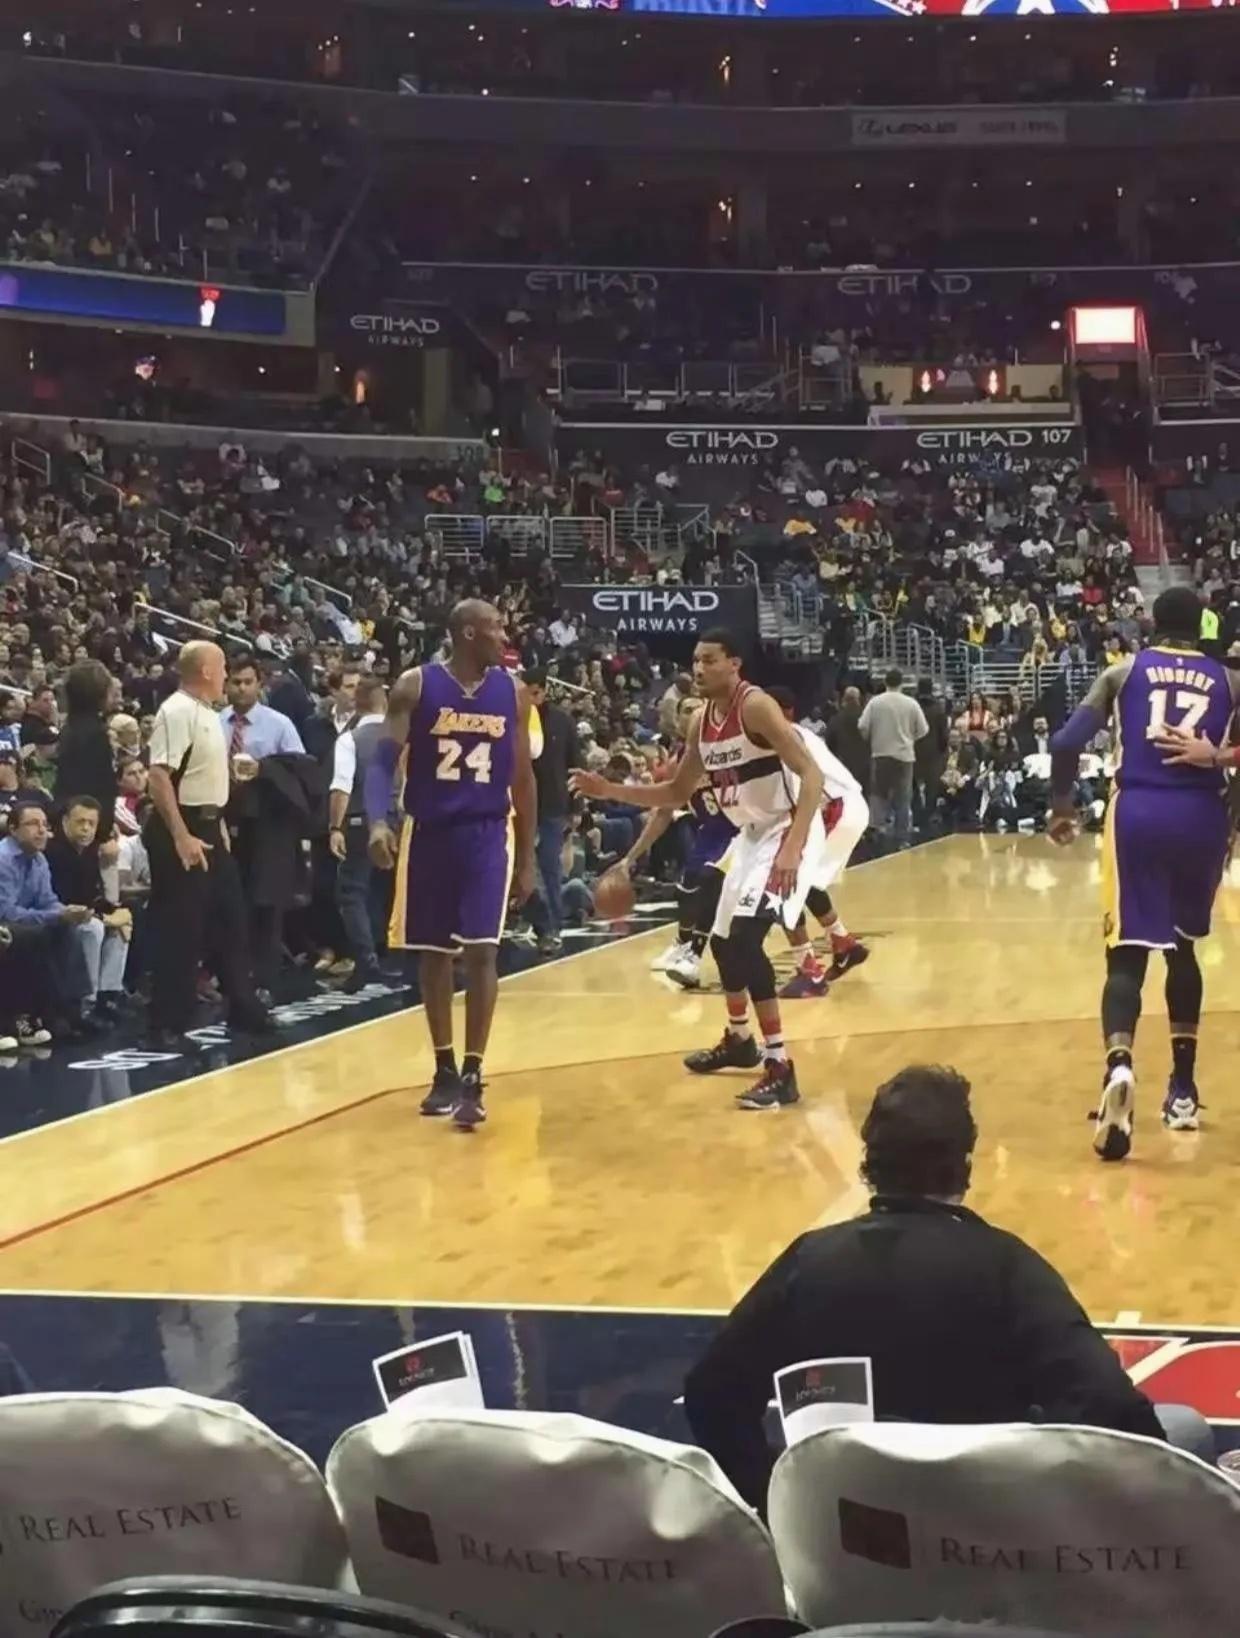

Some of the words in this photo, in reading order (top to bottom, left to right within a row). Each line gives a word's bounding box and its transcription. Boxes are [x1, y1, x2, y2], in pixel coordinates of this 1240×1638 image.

[525, 270, 659, 292] ETIHAD
[350, 314, 440, 333] ETIHAD
[666, 431, 779, 449] ETIHAD
[917, 430, 1033, 449] ETIHAD
[1041, 429, 1072, 444] 107
[687, 453, 759, 465] AIRWAYS
[938, 451, 1011, 465] AIRWYS
[592, 590, 720, 612] ETIHAD
[617, 617, 698, 631] AIRWAYS
[1146, 689, 1211, 741] 17
[436, 738, 492, 784] 24
[18, 1514, 106, 1542] REAL
[117, 1497, 242, 1536] ESTATE
[457, 1533, 546, 1575] REAL
[553, 1550, 681, 1584] ESTATE
[939, 1536, 1031, 1572] REAL
[1055, 1544, 1194, 1575] ESTATE
